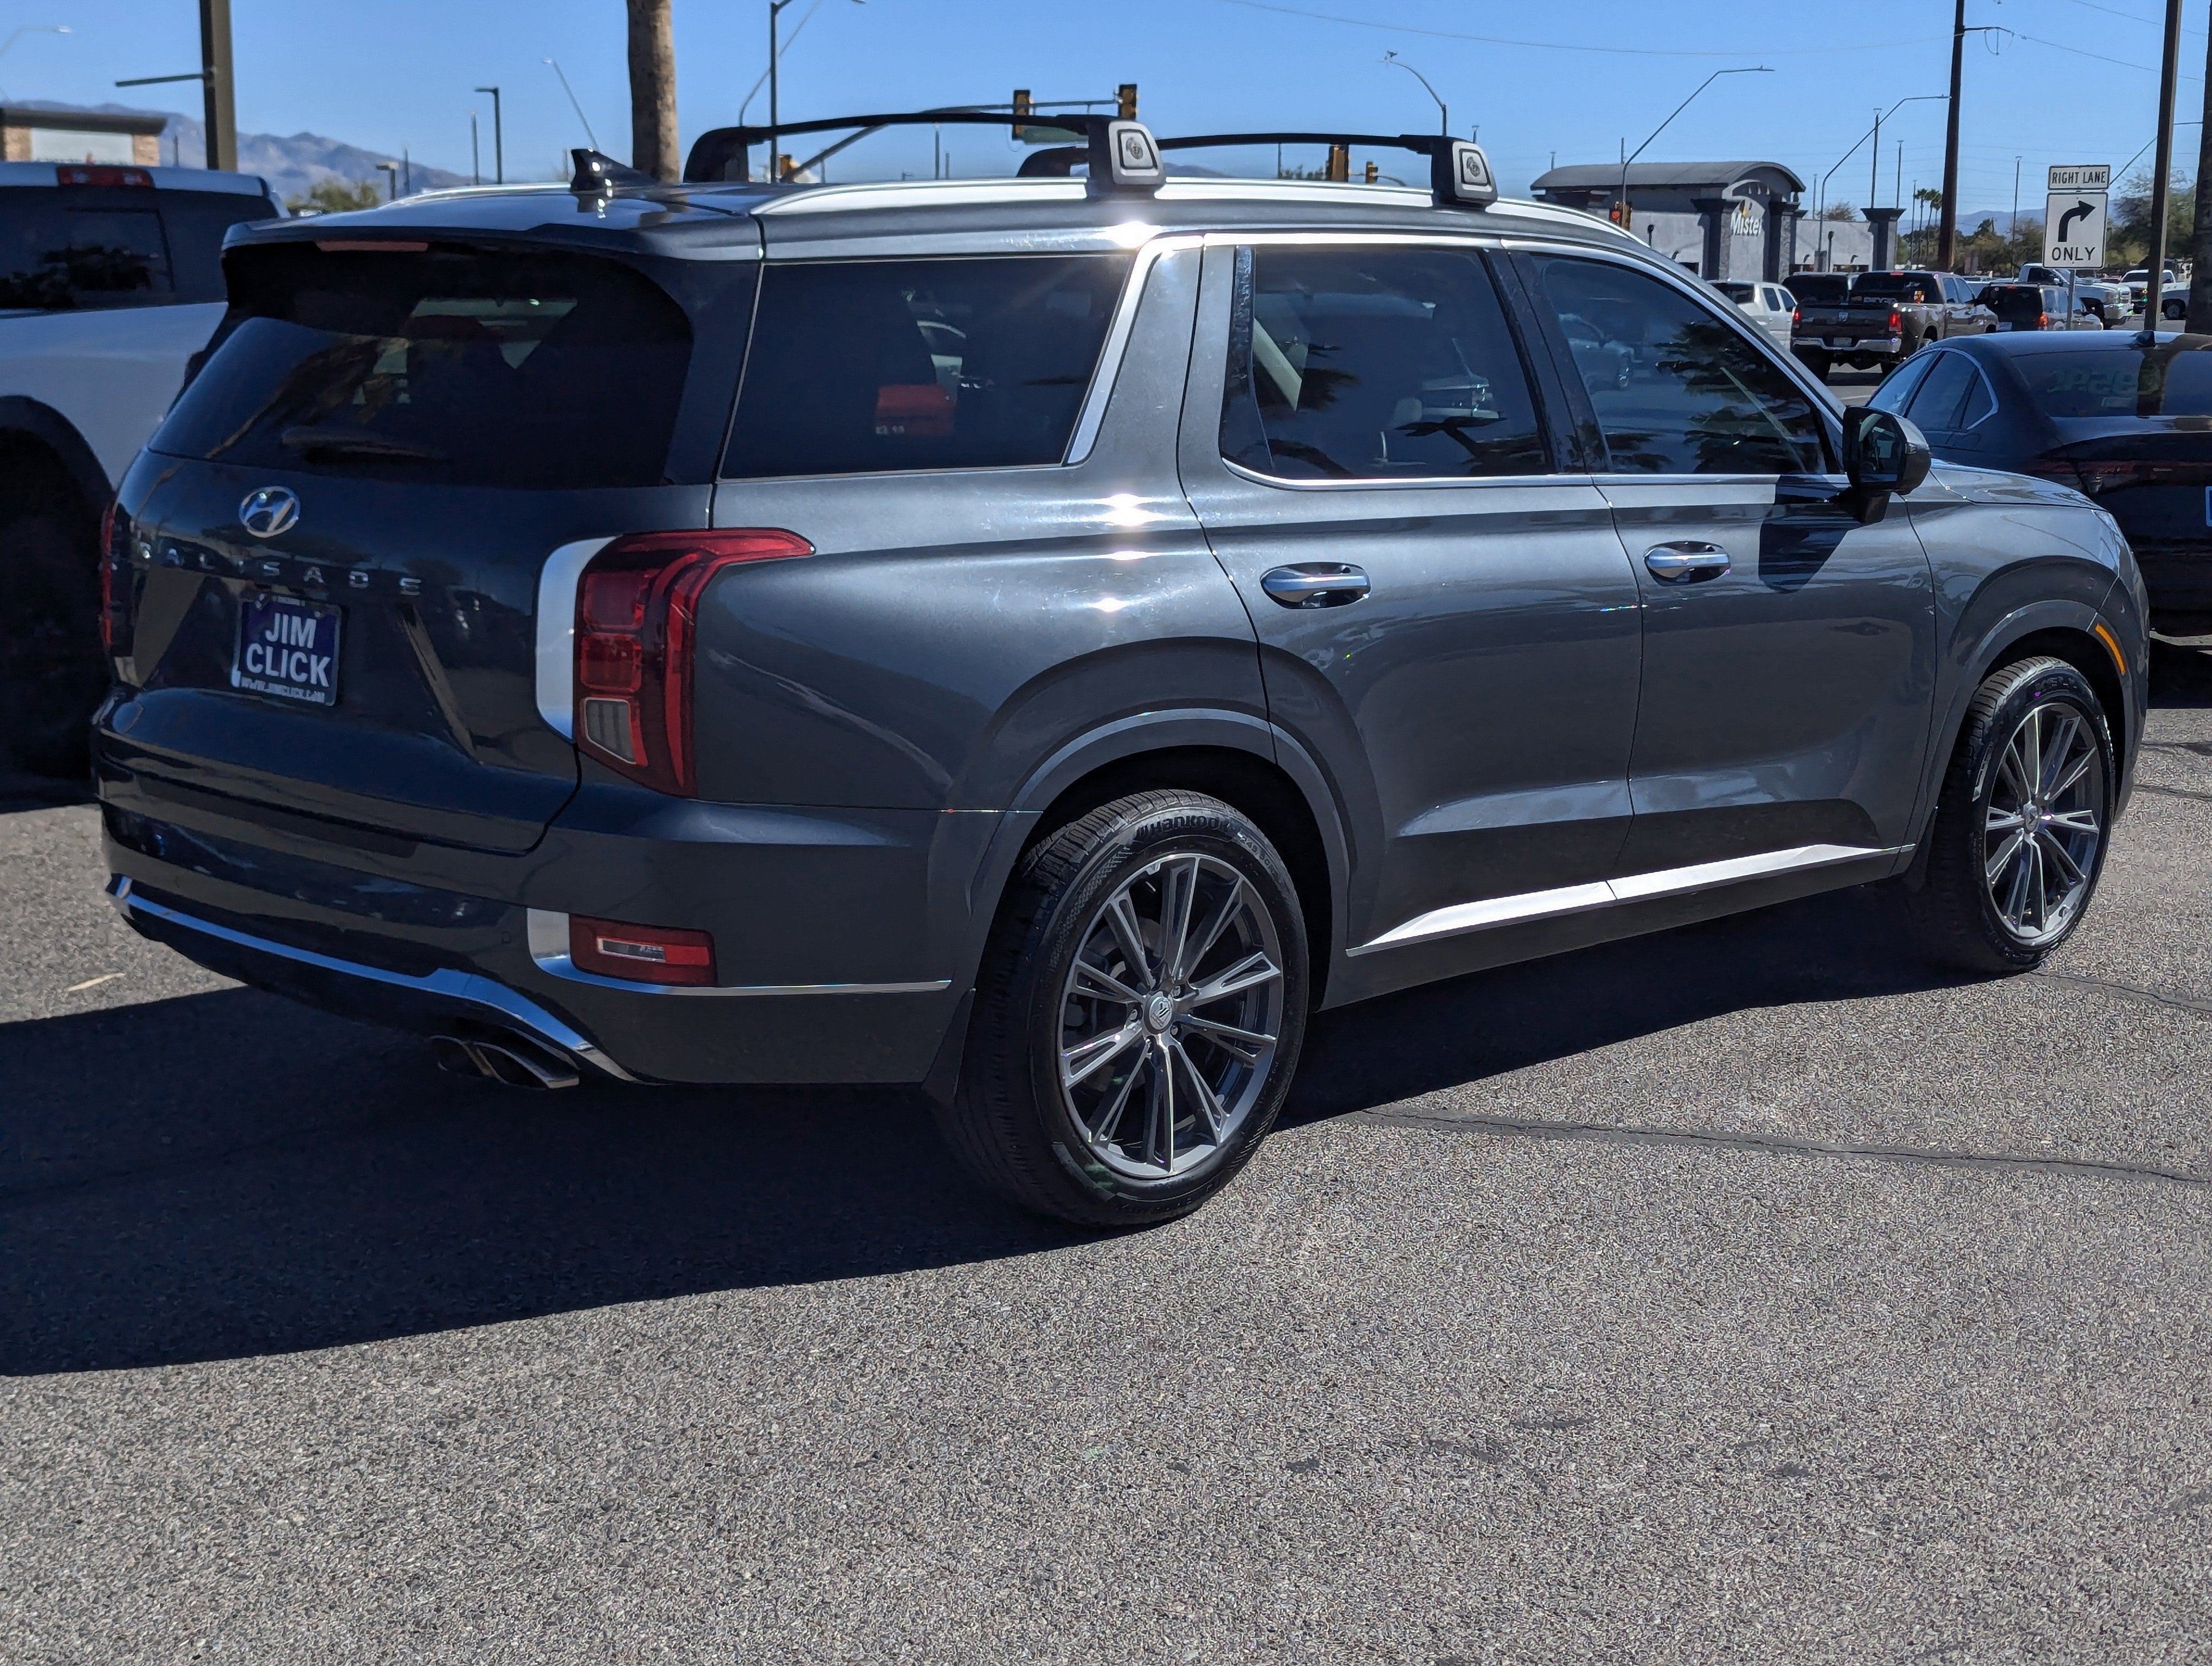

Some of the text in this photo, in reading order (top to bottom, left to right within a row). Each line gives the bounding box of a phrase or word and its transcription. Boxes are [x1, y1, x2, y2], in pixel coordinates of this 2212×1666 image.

[2052, 171, 2106, 184] RIGHT LANE
[1730, 212, 1763, 235] Mister
[2052, 247, 2096, 261] ONLY
[265, 613, 317, 649] JIM
[246, 643, 331, 687] CLICK
